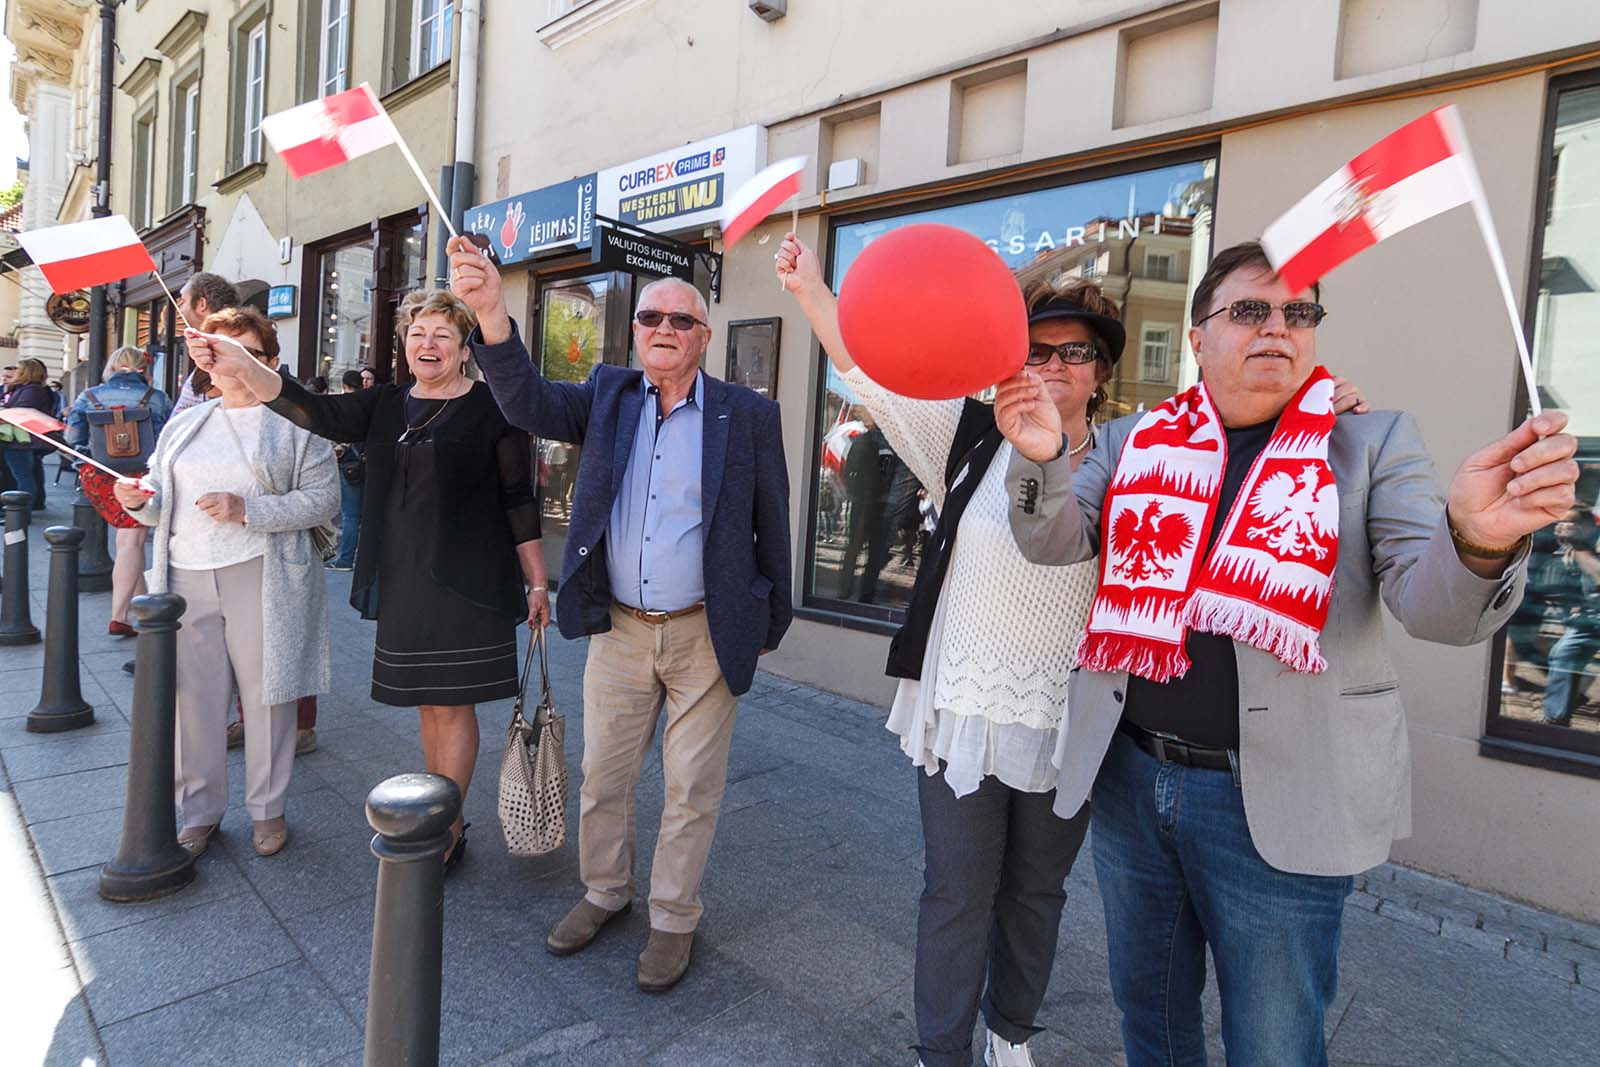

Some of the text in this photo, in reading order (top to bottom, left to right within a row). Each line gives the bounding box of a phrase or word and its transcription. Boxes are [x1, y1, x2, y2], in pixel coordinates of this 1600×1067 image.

[618, 154, 709, 192] CURREX PRIME
[621, 189, 676, 214] WESTERN
[637, 202, 676, 221] UNION
[608, 234, 689, 267] VALIUTOS KEITYKLA
[626, 254, 673, 275] EXCHANGE
